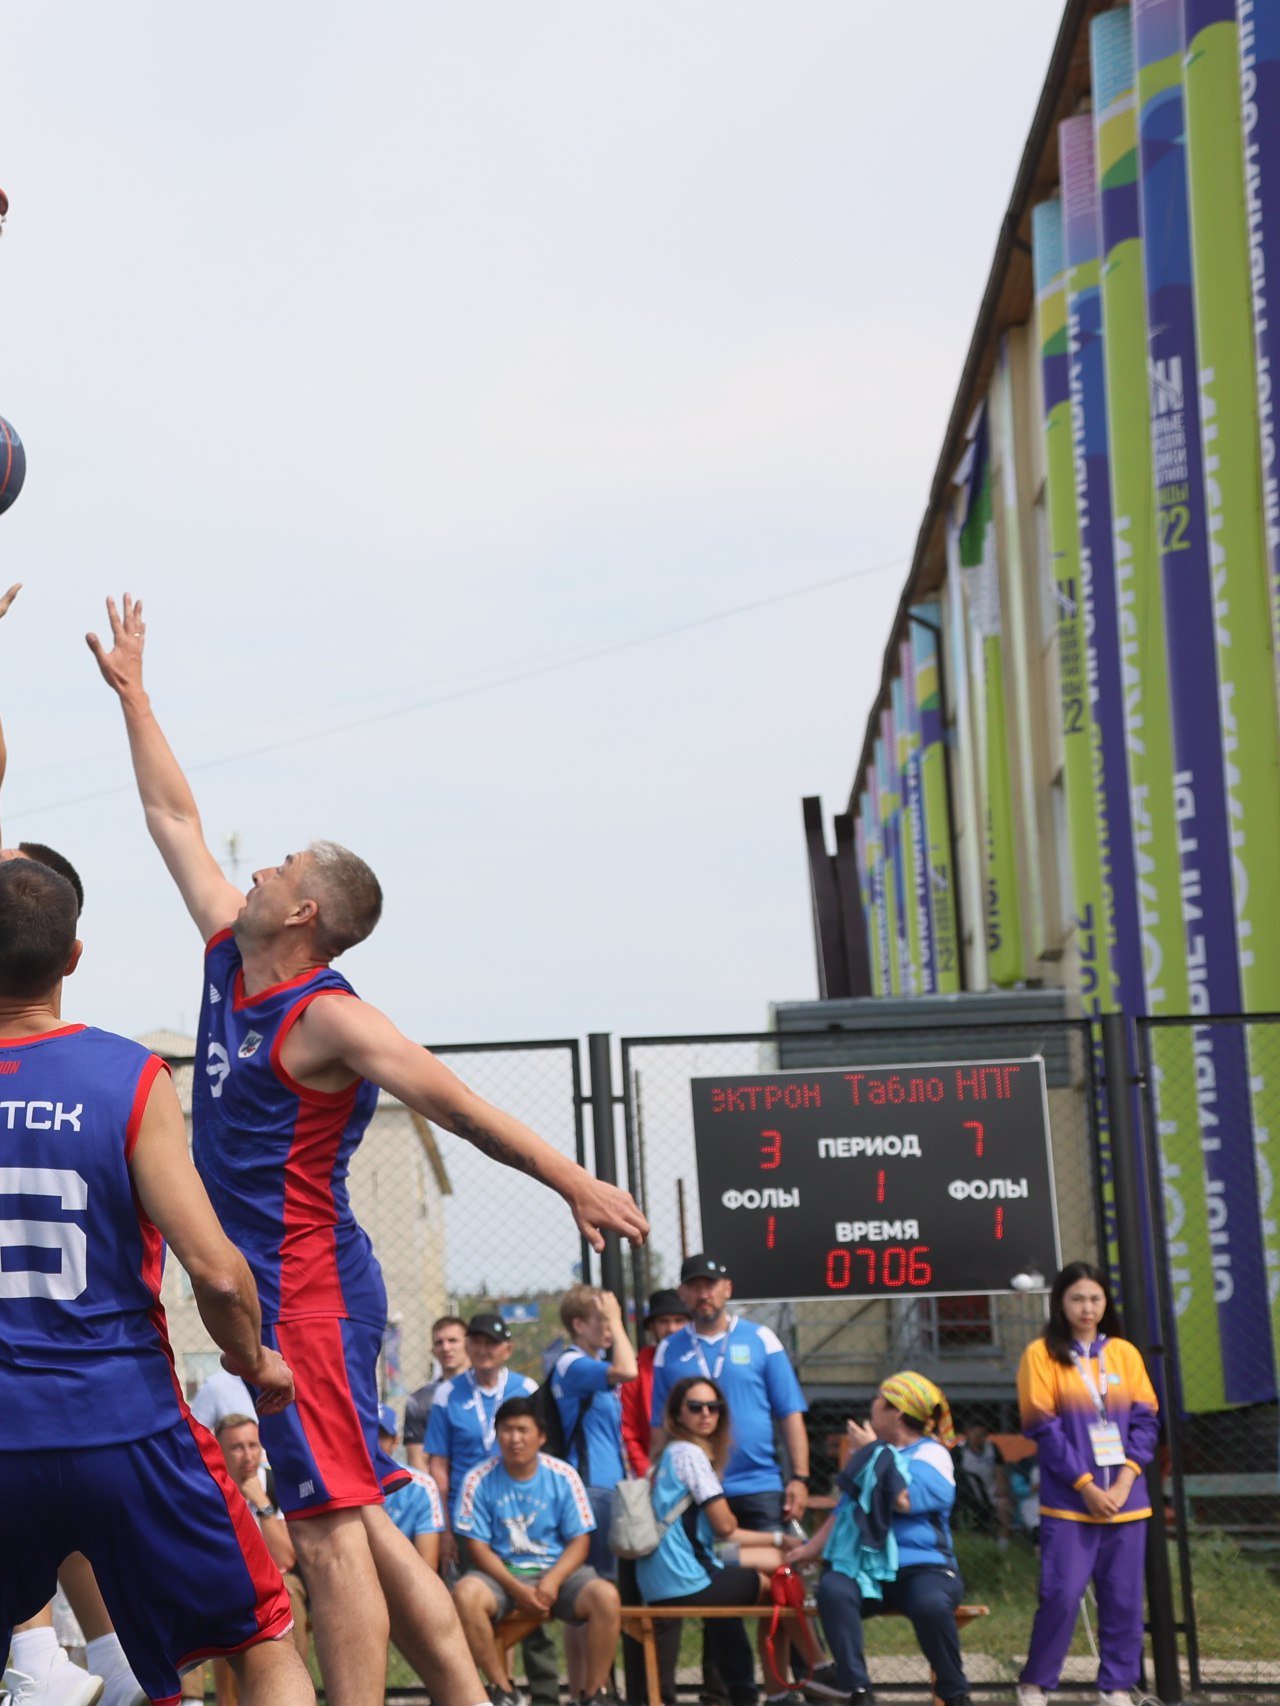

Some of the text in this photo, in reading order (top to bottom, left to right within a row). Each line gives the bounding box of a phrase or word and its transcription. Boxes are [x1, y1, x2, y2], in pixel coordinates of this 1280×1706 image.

[843, 1074, 944, 1106] Табло
[760, 1129, 782, 1170] 3
[818, 1134, 922, 1159] ПЕРИОД
[961, 1120, 984, 1158] 7
[721, 1187, 800, 1211] ФОЛЫ
[876, 1168, 886, 1204] 1
[947, 1178, 1029, 1202] ФОЛЫ
[766, 1215, 776, 1250] 1
[835, 1218, 920, 1244] ВРЕМЯ
[994, 1205, 1004, 1241] 1
